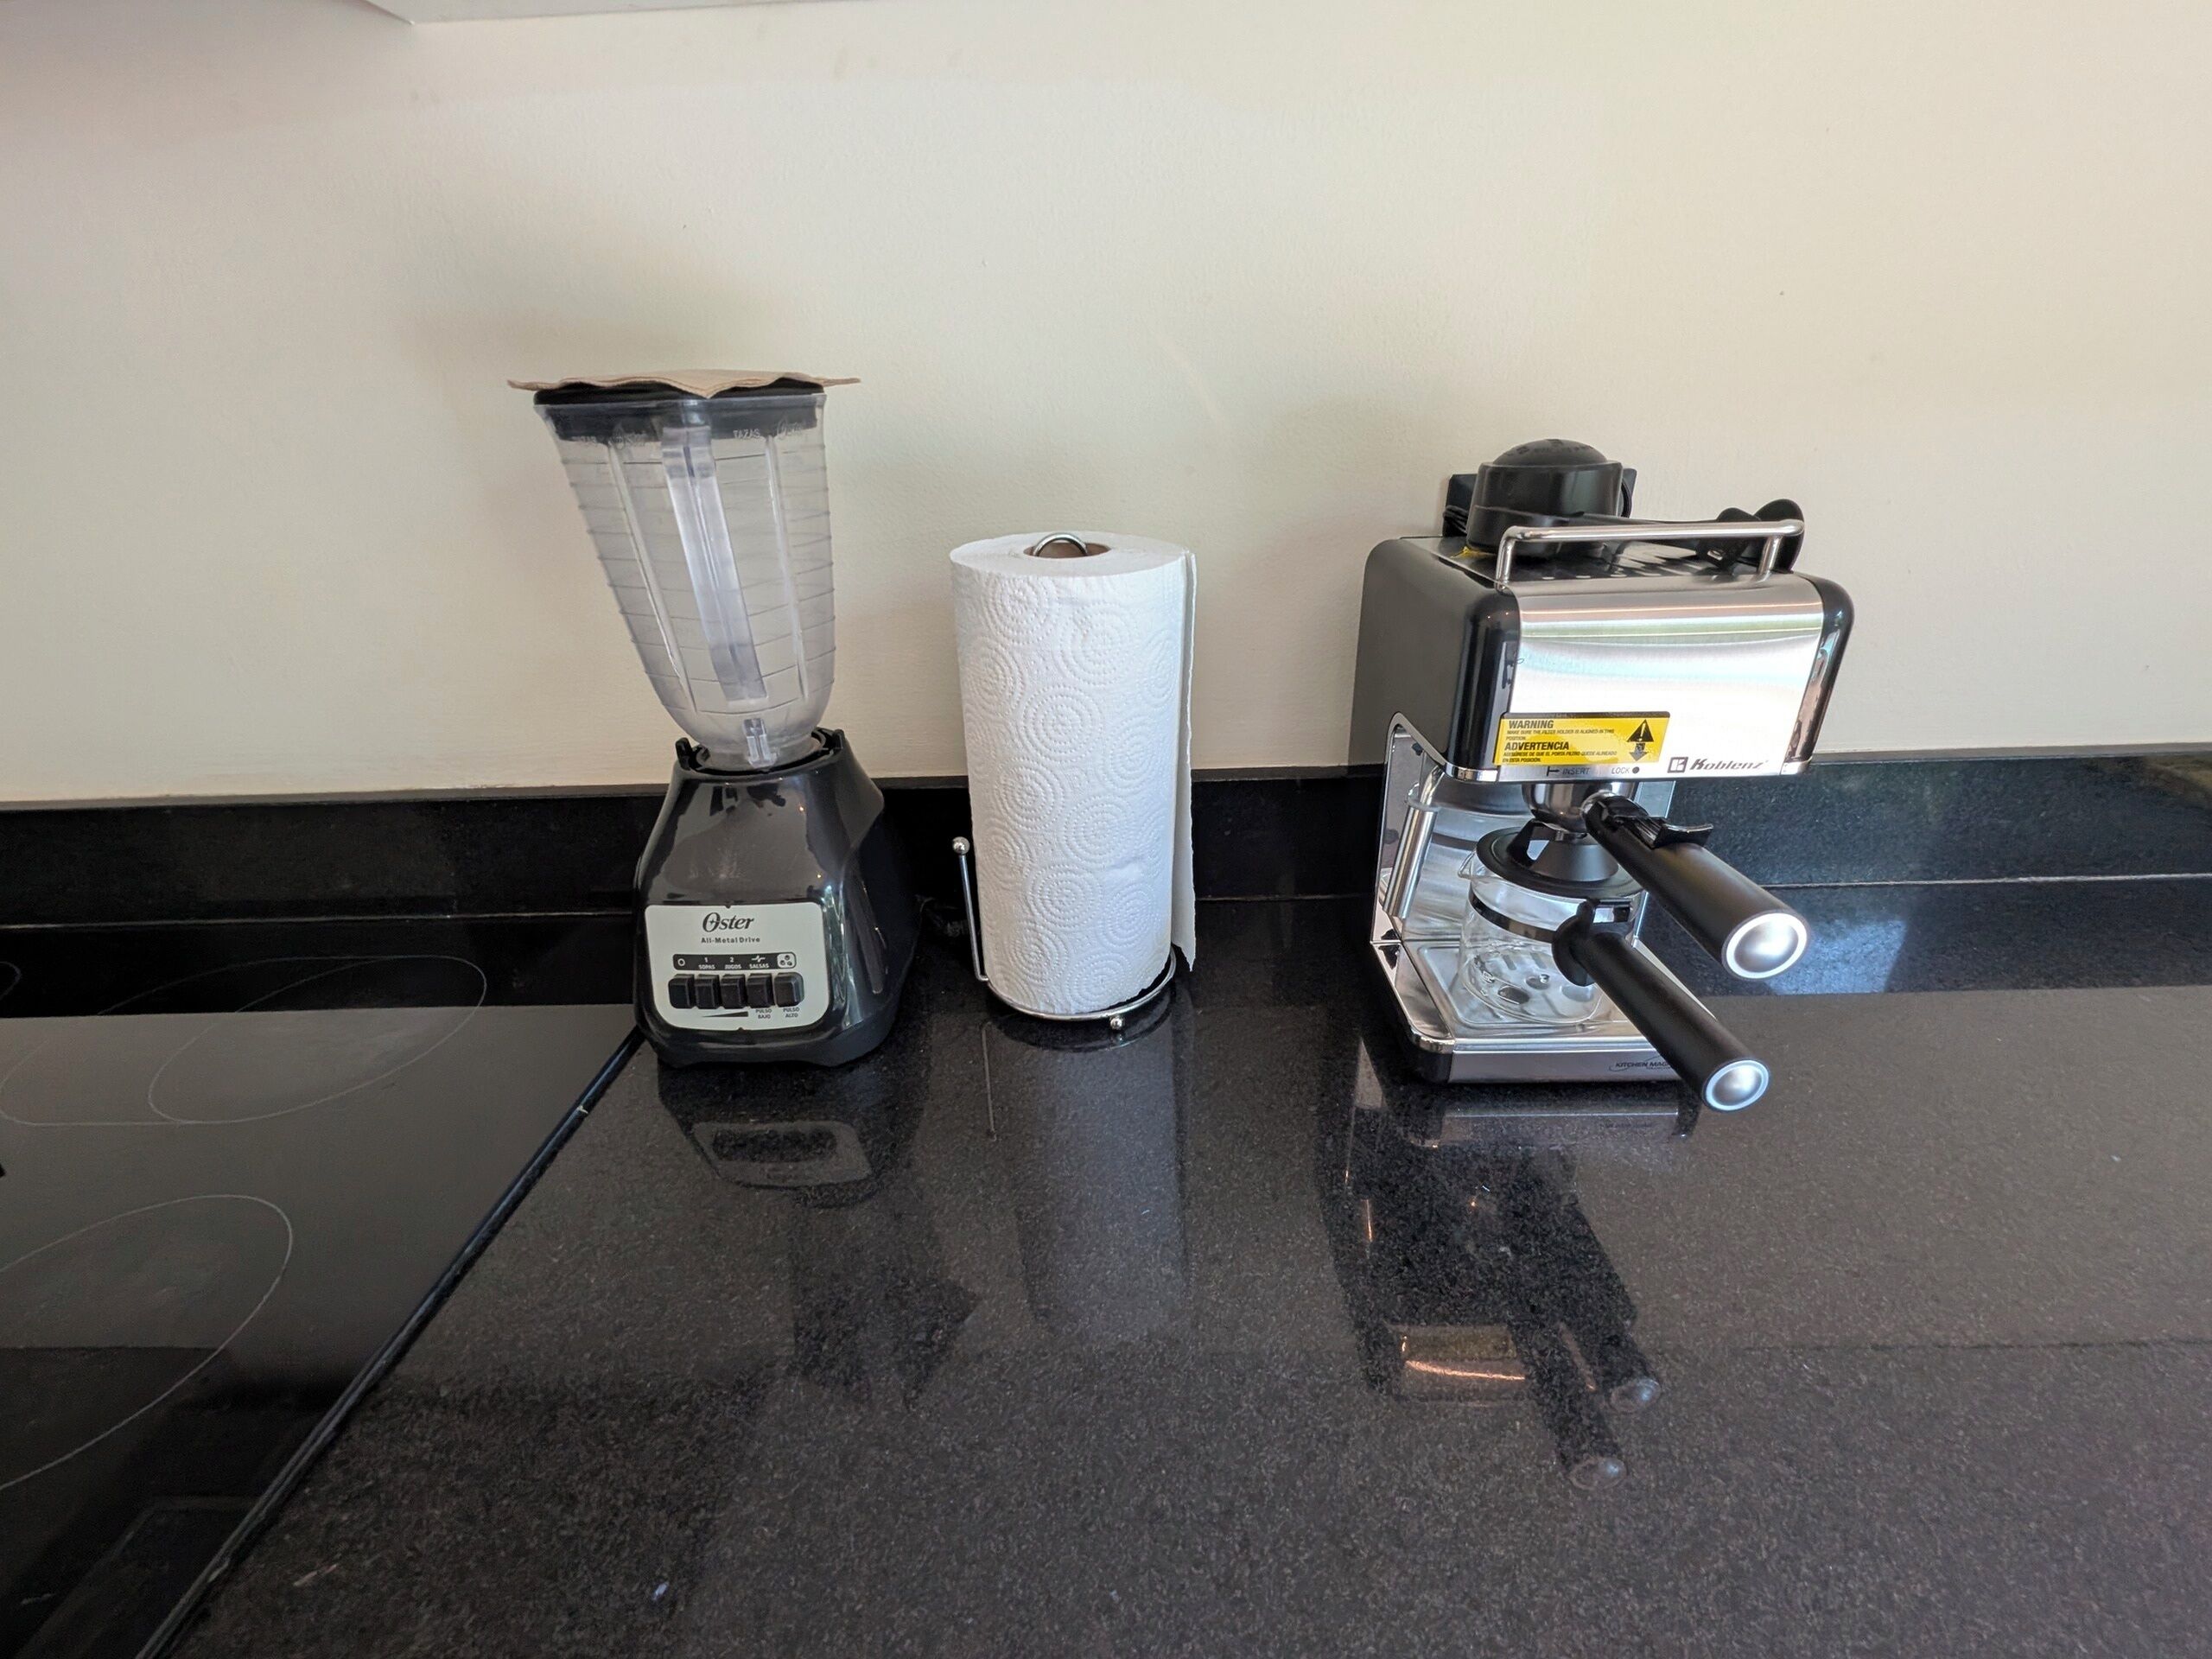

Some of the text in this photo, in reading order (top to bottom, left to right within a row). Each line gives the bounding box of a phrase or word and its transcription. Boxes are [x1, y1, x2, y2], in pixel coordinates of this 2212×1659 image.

[1509, 720, 1554, 729] WARNING
[1504, 741, 1570, 751] ADVERTENCIA
[1689, 759, 1763, 771] Koblenz
[702, 912, 754, 932] Oster
